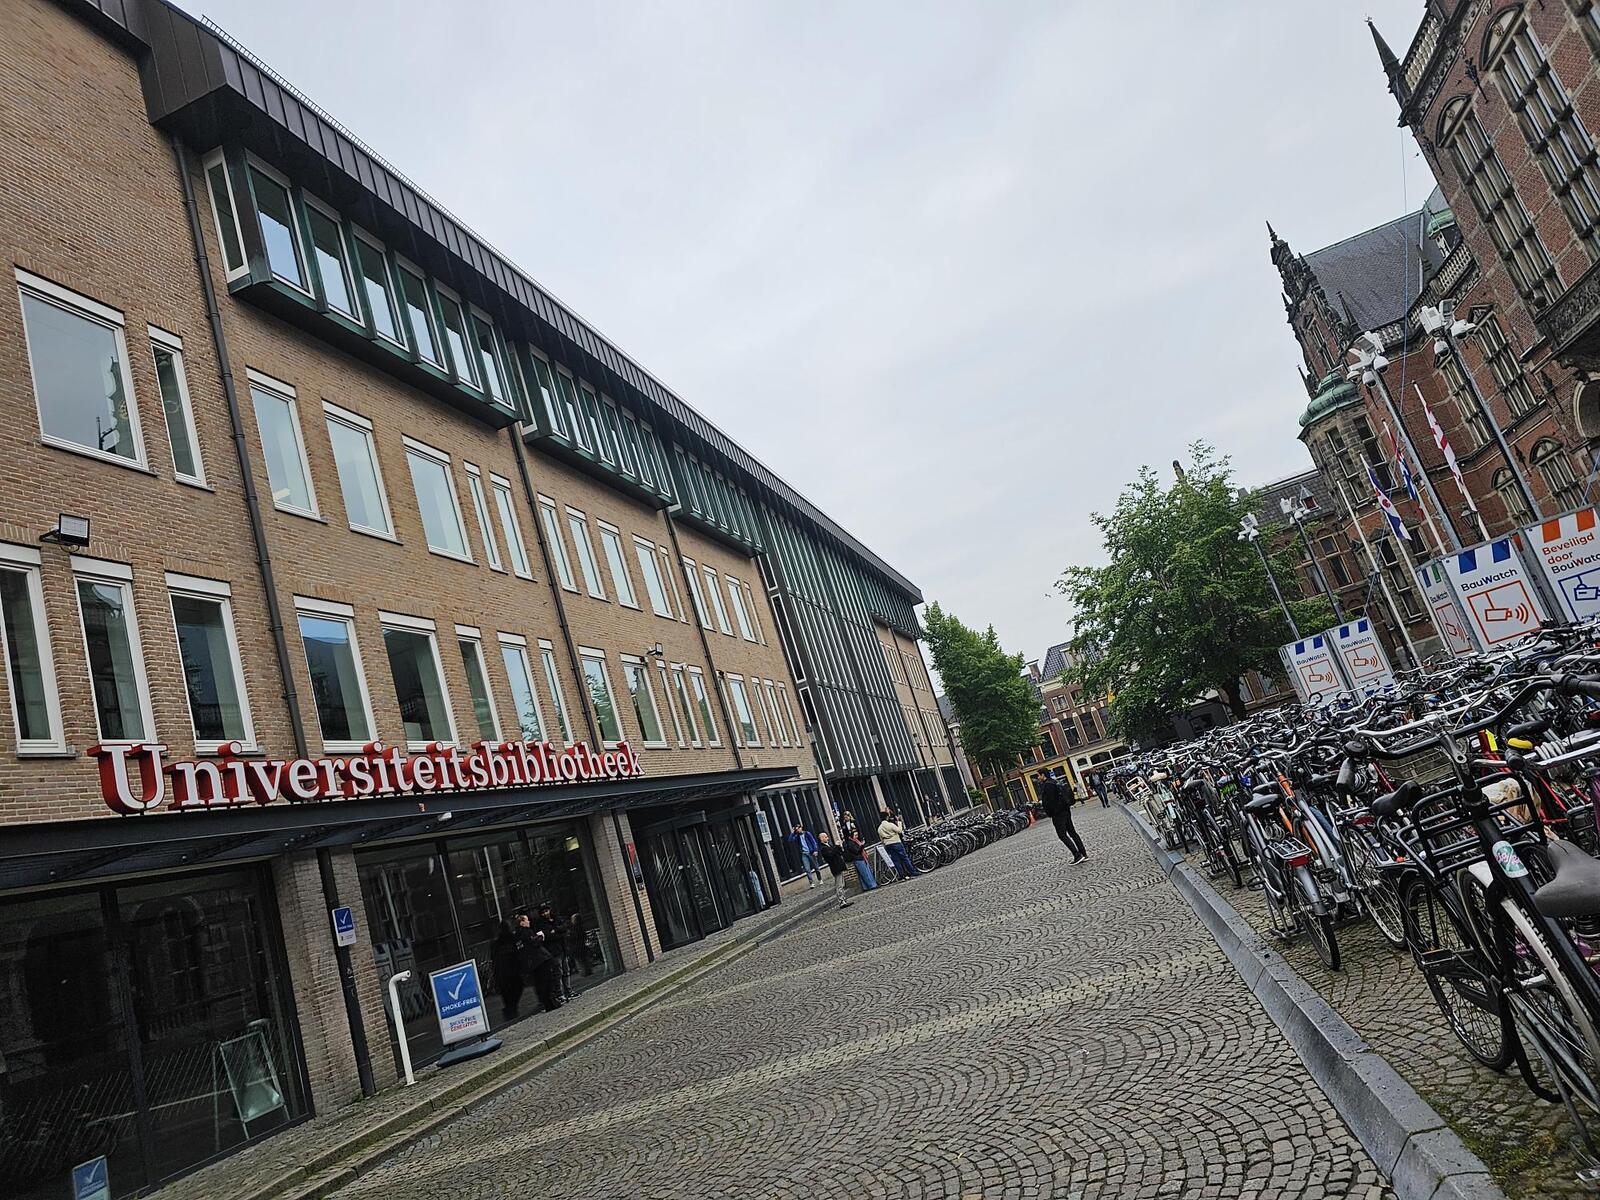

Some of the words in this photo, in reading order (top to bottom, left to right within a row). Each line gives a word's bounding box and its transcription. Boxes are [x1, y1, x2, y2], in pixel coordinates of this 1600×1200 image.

[1542, 533, 1595, 555] Beveiligd
[1547, 551, 1574, 565] door
[1460, 568, 1518, 592] BauWatch
[87, 740, 645, 815] Universiteitsbibliotheek
[441, 996, 477, 1013] SMOKE-FREE
